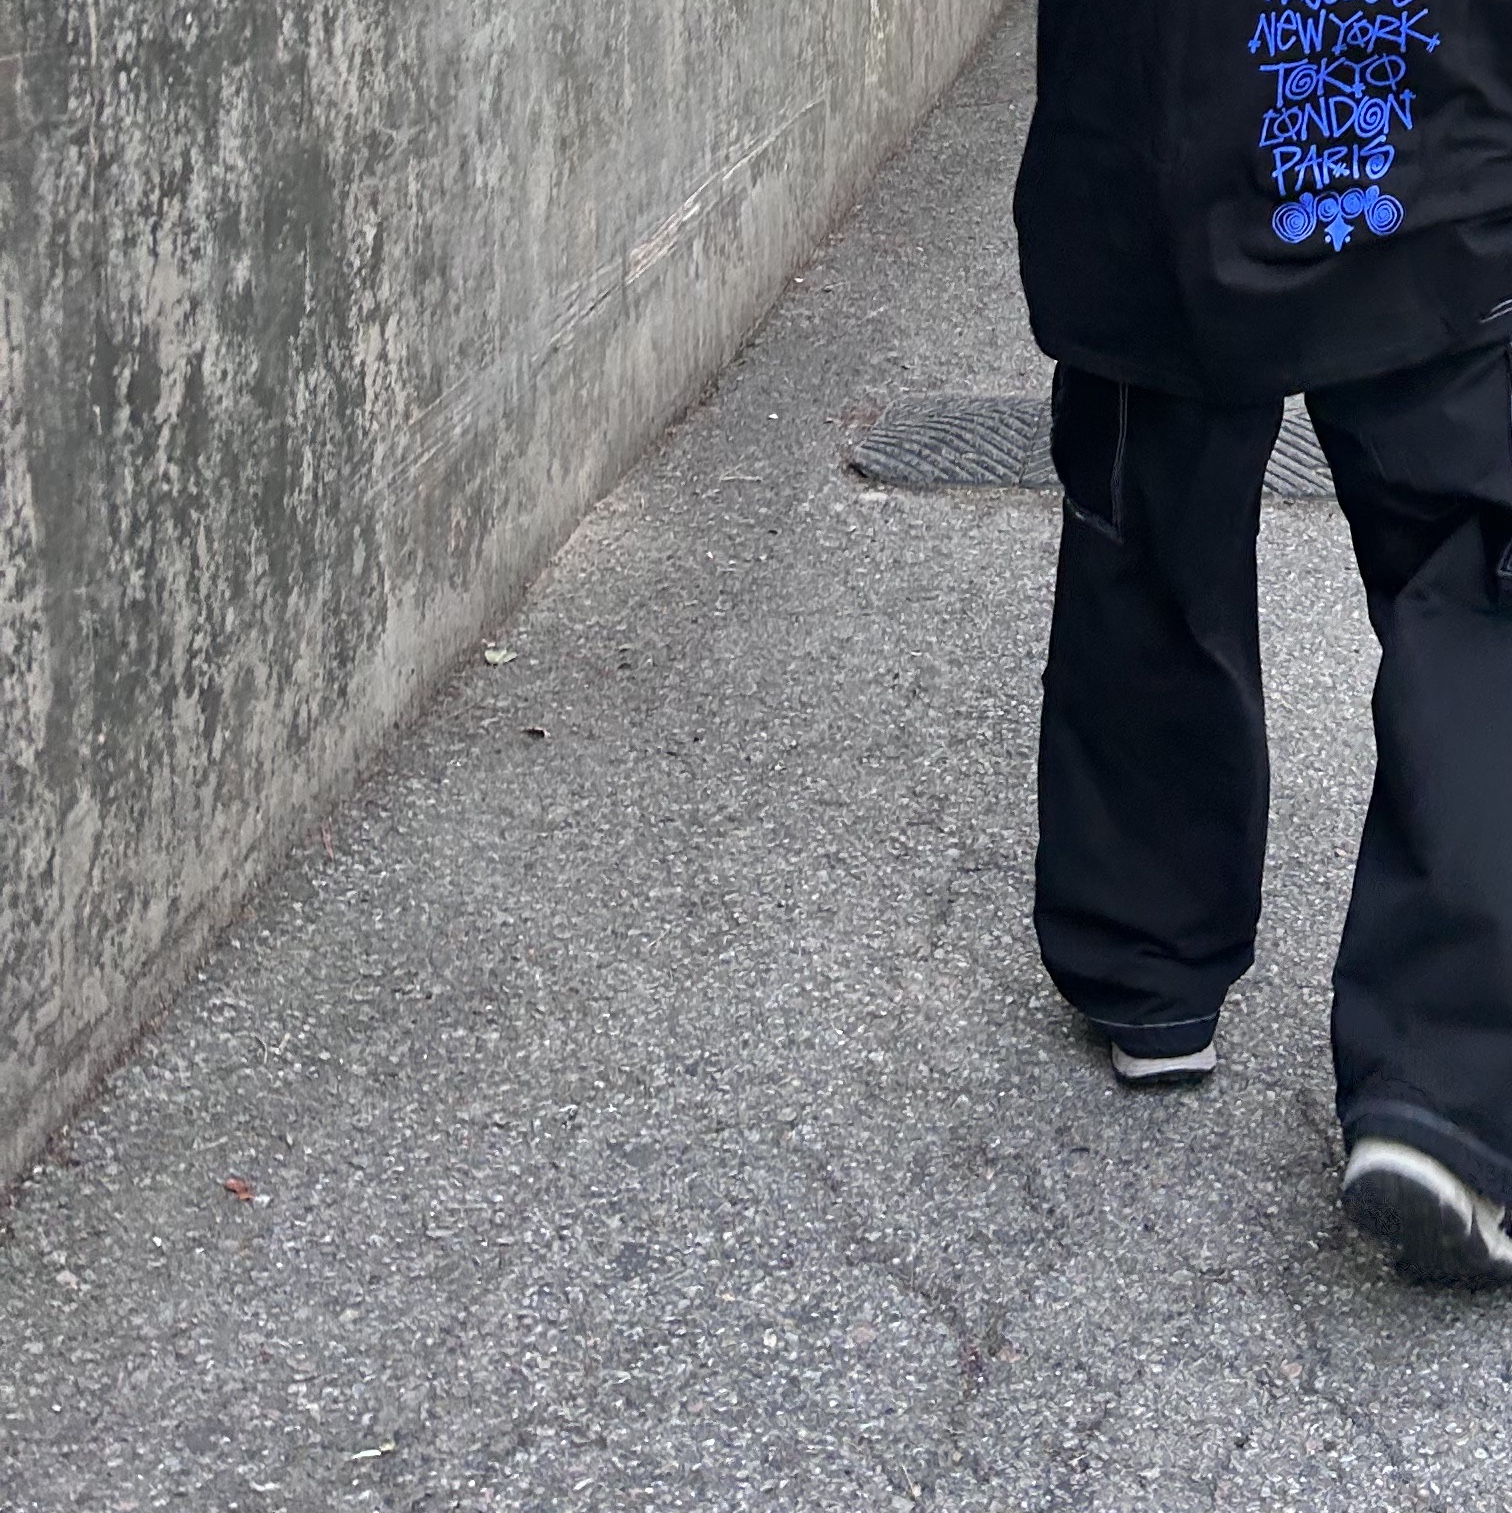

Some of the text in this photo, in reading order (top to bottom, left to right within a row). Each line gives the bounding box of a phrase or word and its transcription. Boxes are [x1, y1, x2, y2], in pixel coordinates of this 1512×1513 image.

[1328, 7, 1441, 56] YORK
[1259, 53, 1407, 108] TOKYO
[1258, 88, 1417, 148] LONDON
[1271, 134, 1396, 196] PARIS
